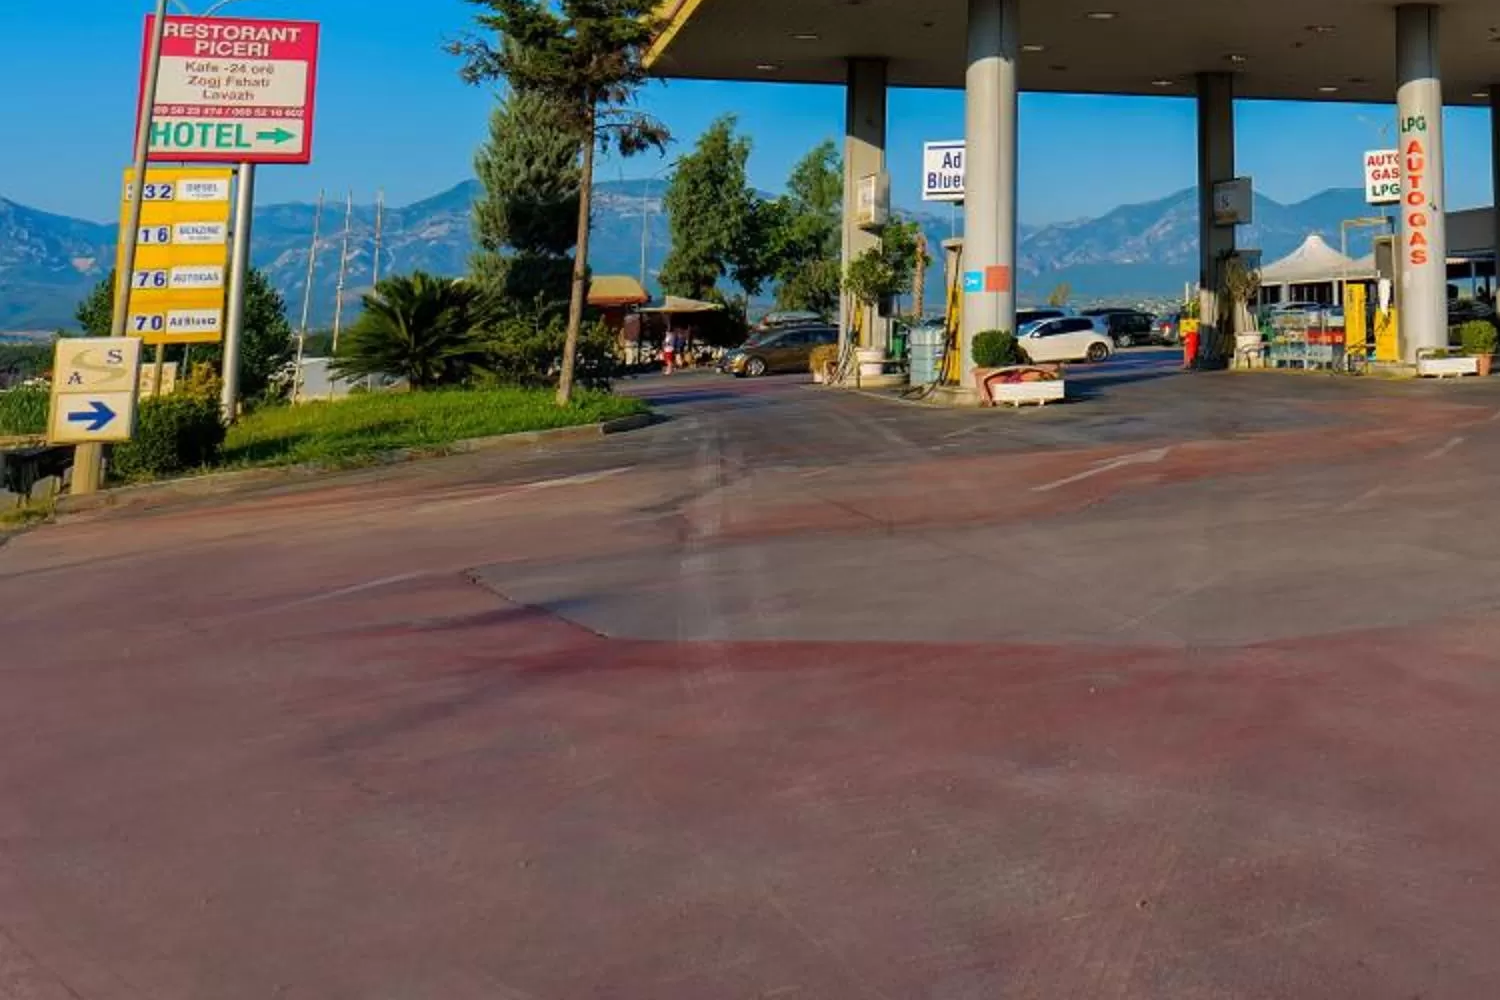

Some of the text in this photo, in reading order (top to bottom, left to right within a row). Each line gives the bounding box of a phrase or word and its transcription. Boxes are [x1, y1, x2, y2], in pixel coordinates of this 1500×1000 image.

[162, 22, 301, 43] RESTORANT
[194, 40, 270, 57] PICERI
[187, 75, 221, 89] Zogj
[202, 89, 255, 101] Lavazh
[1401, 115, 1427, 133] LPG
[151, 121, 253, 148] HOTEL
[941, 151, 962, 169] Ad
[1371, 169, 1400, 181] GAS
[1372, 183, 1401, 198] LPG
